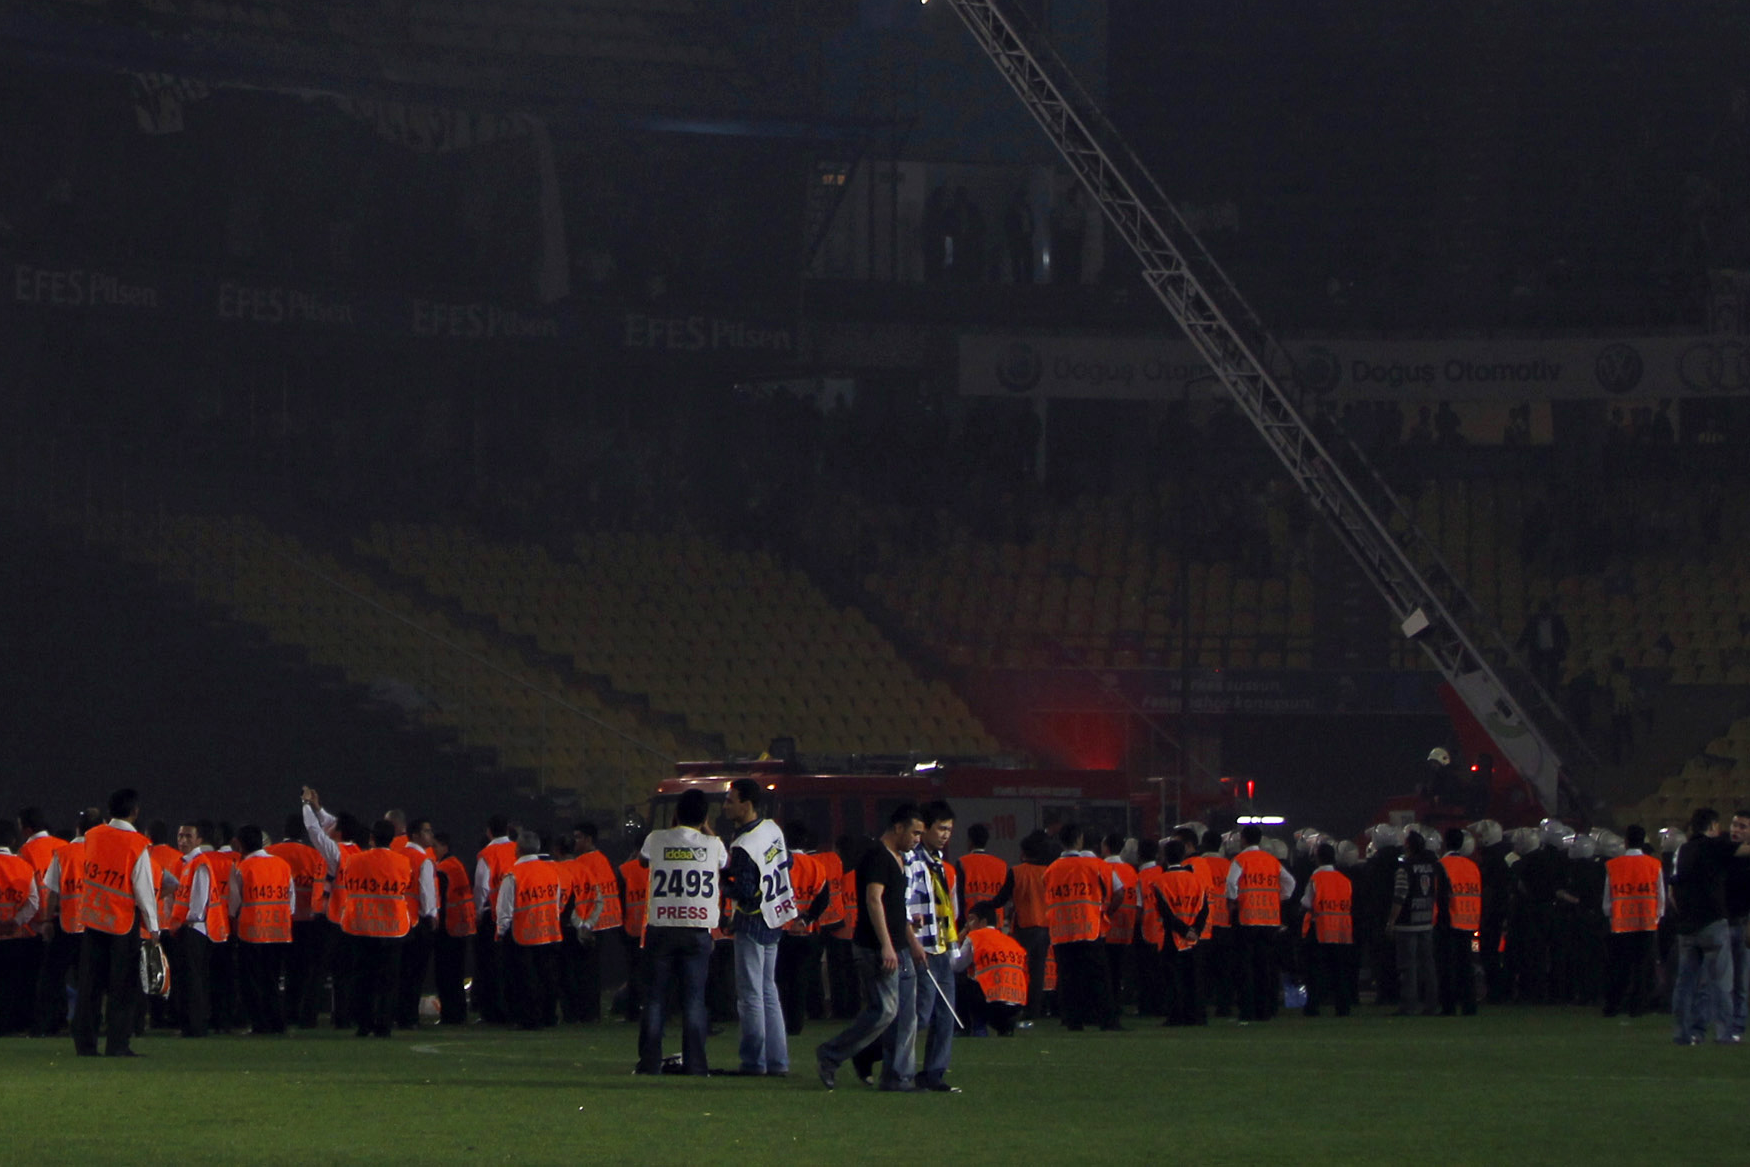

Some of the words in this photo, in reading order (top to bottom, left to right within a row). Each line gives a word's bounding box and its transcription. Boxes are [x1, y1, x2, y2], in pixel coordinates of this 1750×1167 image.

[16, 264, 84, 307] EFES
[89, 272, 158, 309] Pilsen
[219, 282, 284, 323] EFES
[412, 298, 485, 338] EFES
[625, 313, 707, 350] EFES
[1351, 359, 1436, 388] Doğuş
[1444, 359, 1562, 383] Otomotiv
[665, 848, 694, 860] iddaa
[653, 868, 715, 899] 2493
[657, 905, 708, 920] PRESS
